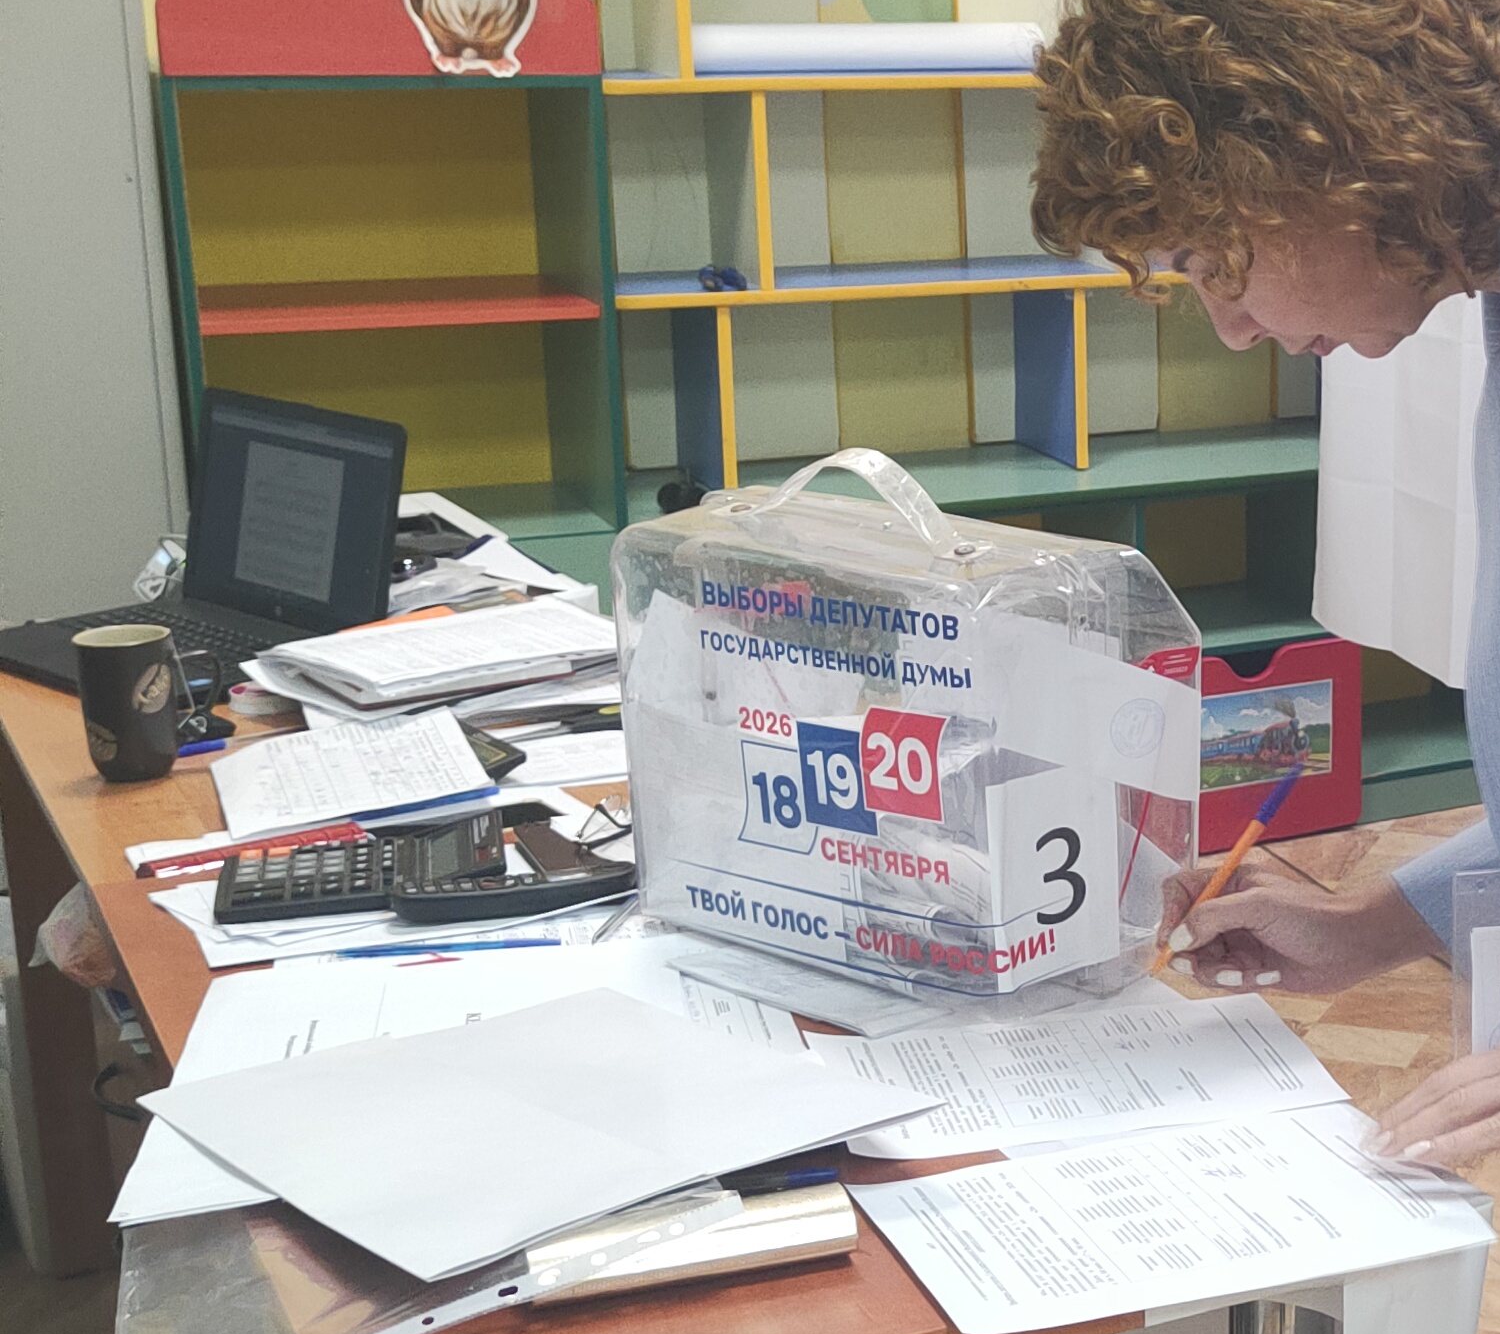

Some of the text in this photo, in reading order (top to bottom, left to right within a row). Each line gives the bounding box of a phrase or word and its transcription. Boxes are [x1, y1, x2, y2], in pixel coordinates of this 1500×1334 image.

[701, 580, 959, 642] ВЫБОРЫ ДЕПУТАТОВ
[700, 629, 972, 689] ГОСУДАРСТВЕННОЙ ДУМЫ
[738, 706, 792, 737] 2026
[752, 731, 933, 829] 18 19 20
[820, 837, 950, 886] СЕНТЯБРЯ
[1035, 825, 1087, 925] 3
[686, 885, 747, 920] ТВОЙ
[751, 902, 829, 940] ГОЛОС
[855, 926, 923, 964] СИЛА
[929, 928, 1056, 975] РОССИИ!
